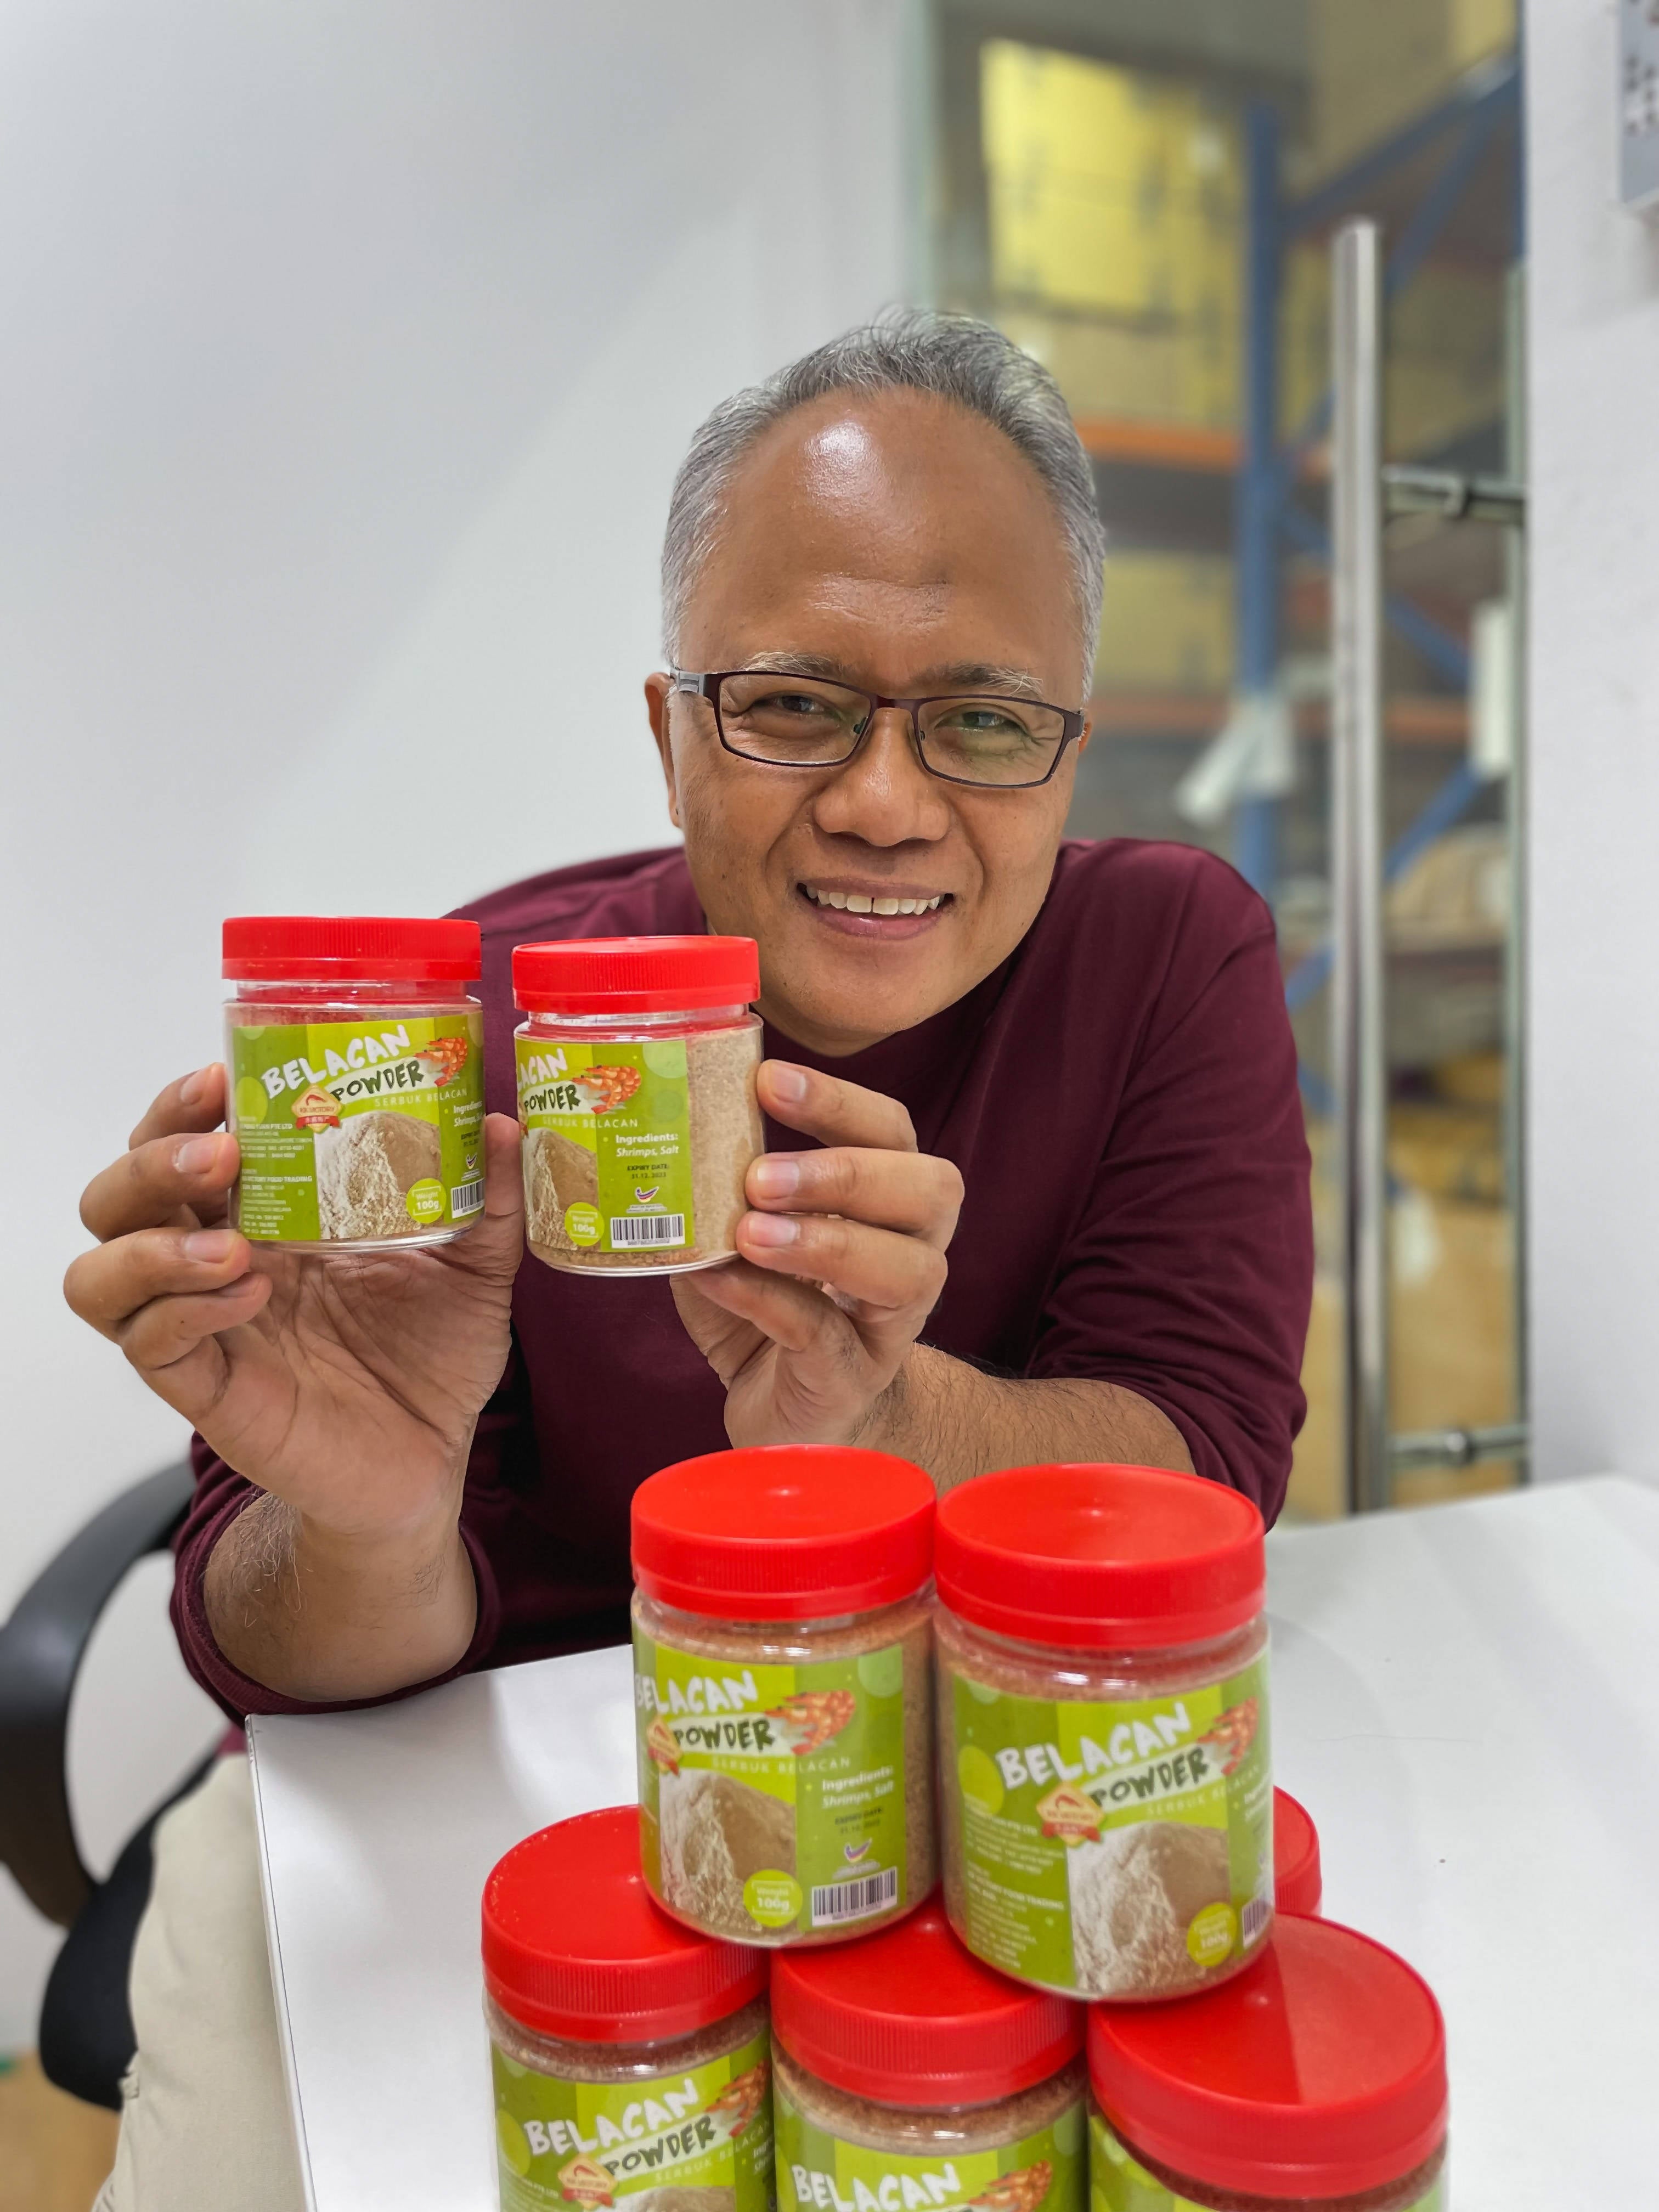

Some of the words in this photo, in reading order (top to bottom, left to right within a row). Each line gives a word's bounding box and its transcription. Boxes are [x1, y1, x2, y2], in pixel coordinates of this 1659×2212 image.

[261, 1024, 410, 1099] BELACAN
[330, 1060, 425, 1102] POWDER
[375, 1094, 421, 1107] SERBUK
[427, 1088, 467, 1102] BELACAN
[524, 1084, 582, 1113] POWDER
[582, 1118, 639, 1128] BELACAN
[616, 1133, 679, 1146] Ingredients:
[660, 1144, 680, 1155] Salt
[417, 1200, 439, 1211] 100g
[573, 1224, 596, 1235] 100g
[674, 1719, 776, 1752] POWDER
[995, 1701, 1191, 1790] BELACAN
[778, 1757, 850, 1774] BELACAN
[822, 1765, 894, 1792] Ingredients:
[1090, 1746, 1209, 1808] POWDER
[757, 1897, 789, 1915] 100g
[523, 2077, 699, 2156] BELACAN
[604, 2115, 718, 2176] POWDER
[792, 2162, 961, 2212] BELACAN
